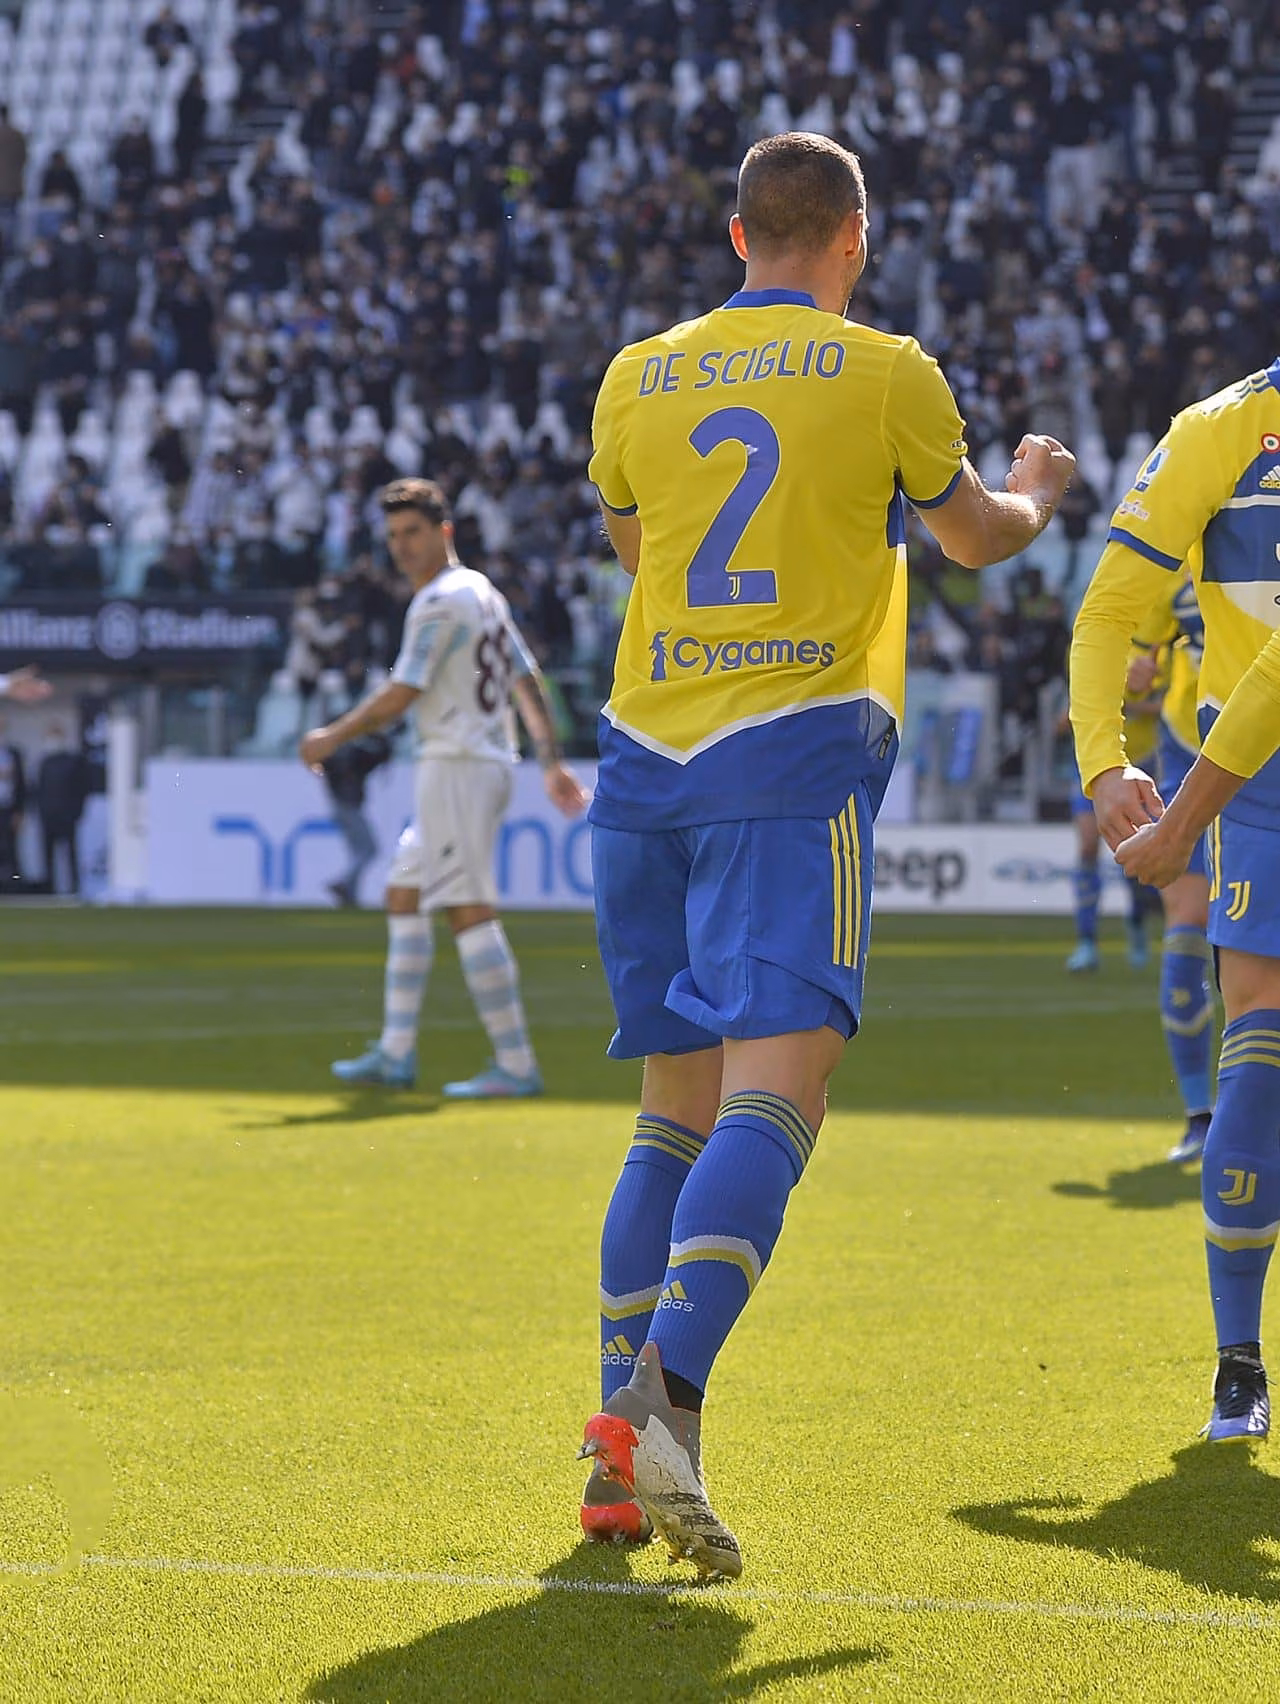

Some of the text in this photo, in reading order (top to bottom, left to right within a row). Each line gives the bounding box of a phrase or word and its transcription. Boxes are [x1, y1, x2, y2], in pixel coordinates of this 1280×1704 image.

[638, 340, 847, 398] DE SCIGLIO
[686, 406, 780, 608] 2
[0, 608, 91, 649] llianz
[672, 636, 836, 675] Cygames
[873, 847, 967, 899] eep
